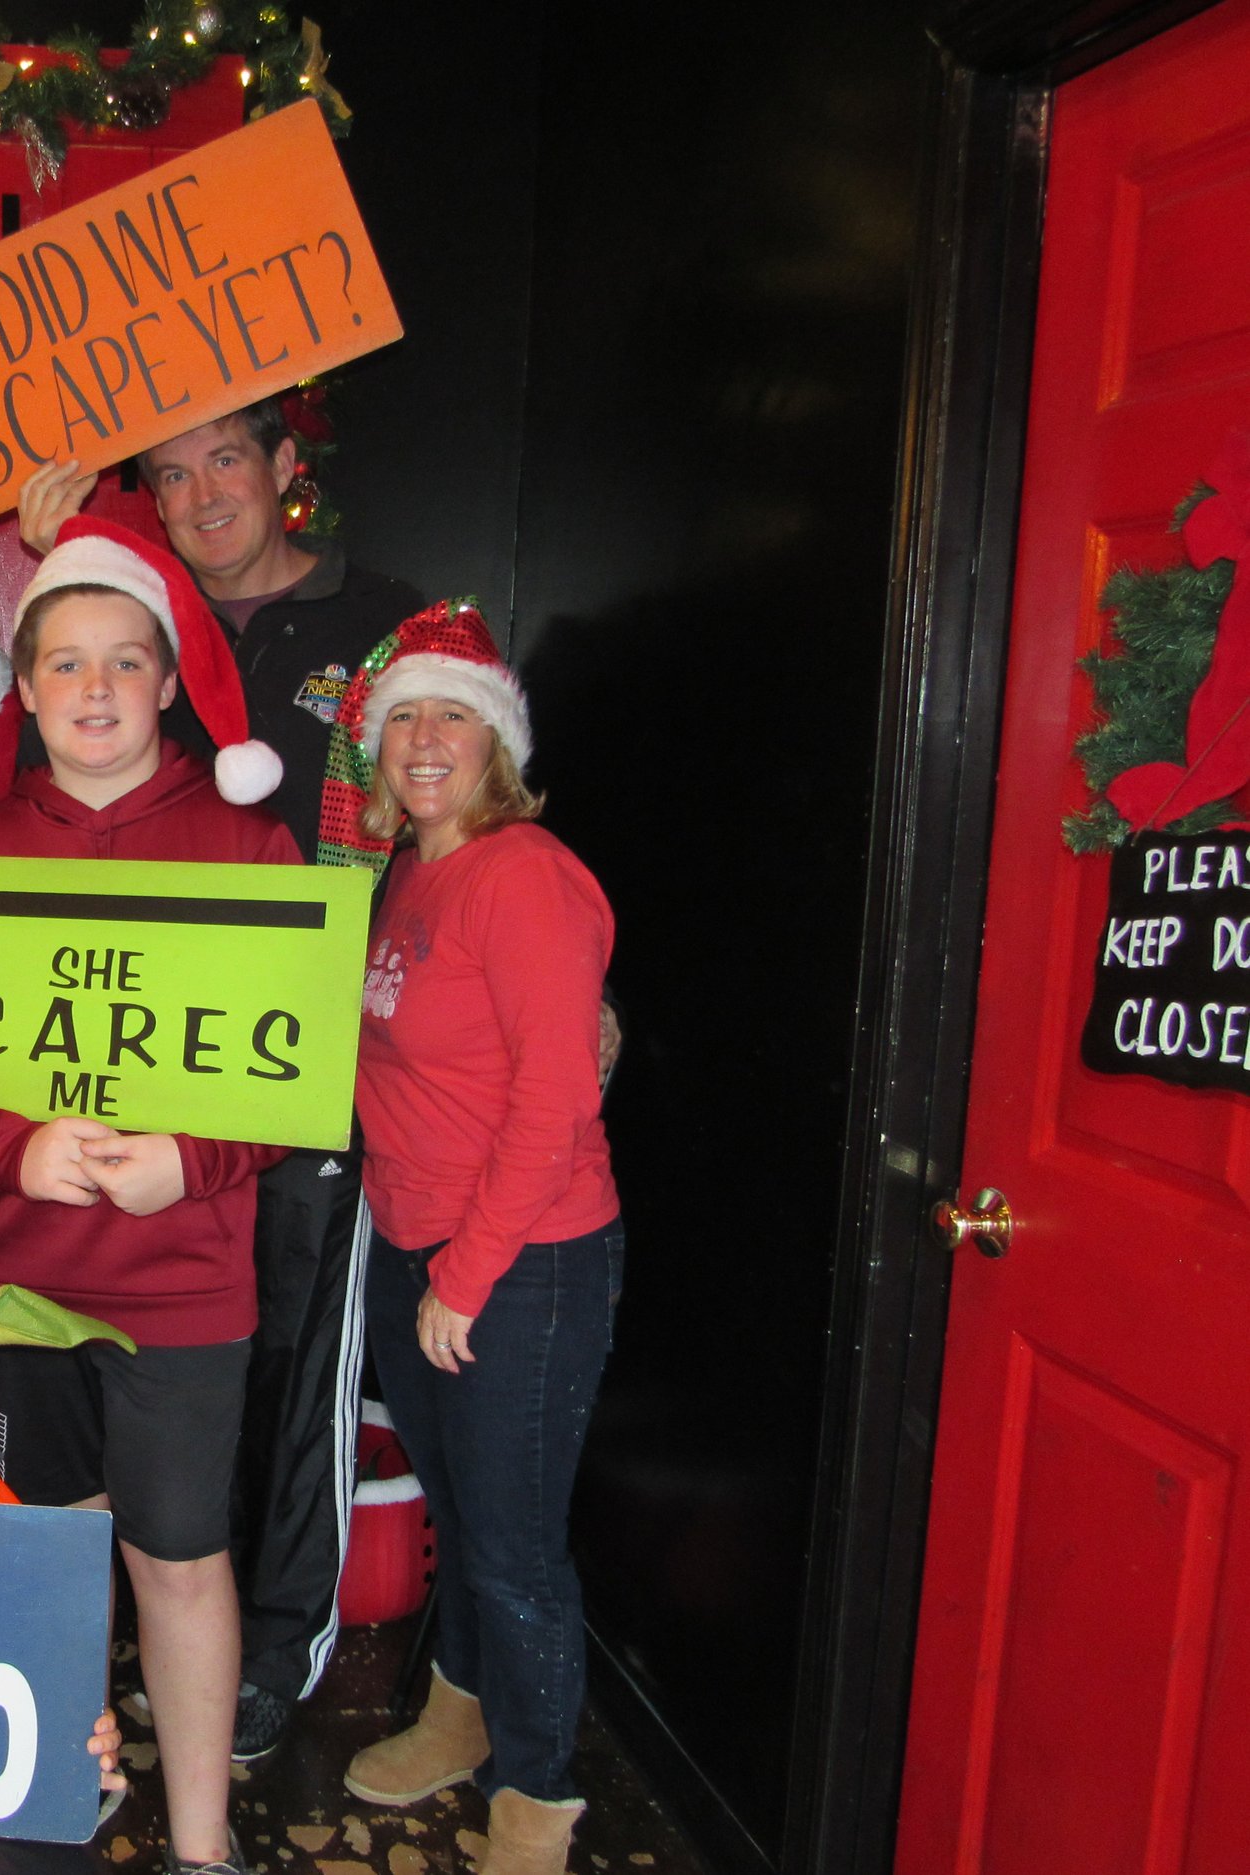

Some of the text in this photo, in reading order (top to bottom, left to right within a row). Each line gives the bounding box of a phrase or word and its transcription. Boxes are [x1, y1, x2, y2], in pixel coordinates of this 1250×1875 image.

[86, 174, 229, 309] WE
[177, 231, 363, 386] YET?
[1143, 846, 1250, 893] PLEA
[48, 946, 145, 992] SHE
[1103, 916, 1181, 969] KEEP
[1114, 998, 1250, 1071] CLOSE
[48, 1072, 121, 1117] ME
